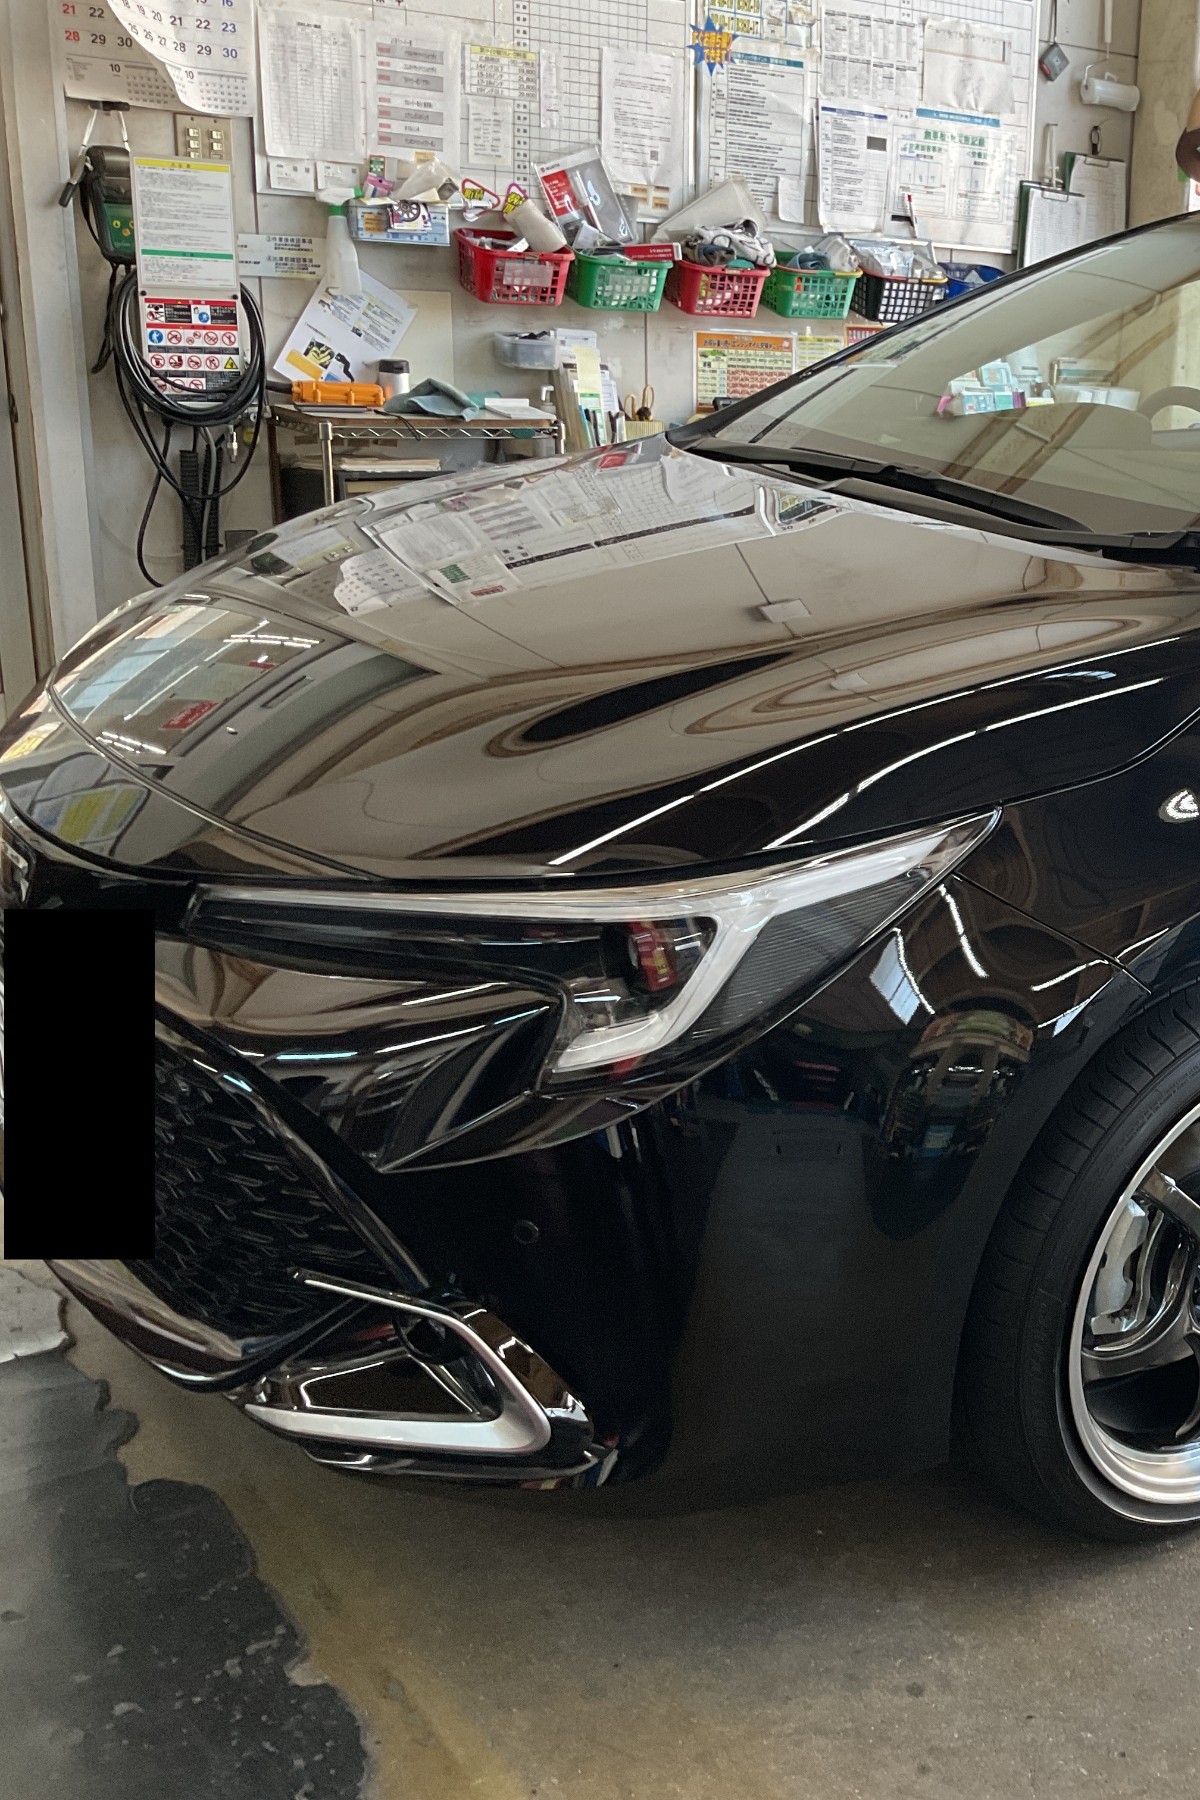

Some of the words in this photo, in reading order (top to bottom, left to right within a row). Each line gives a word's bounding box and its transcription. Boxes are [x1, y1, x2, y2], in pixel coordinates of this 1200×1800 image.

[63, 4, 76, 15] 21
[89, 7, 105, 18] 22
[136, 4, 146, 16] 19
[151, 10, 162, 22] 20
[169, 15, 183, 27] 21
[195, 19, 211, 30] 22
[221, 22, 237, 33] 23
[65, 30, 80, 42] 28
[91, 33, 106, 45] 29
[117, 36, 133, 48] 30
[128, 23, 139, 36] 25
[143, 29, 154, 42] 26
[173, 41, 186, 53] 28
[197, 44, 212, 56] 29
[222, 48, 238, 59] 30
[109, 63, 121, 73] 10
[184, 70, 194, 80] 10
